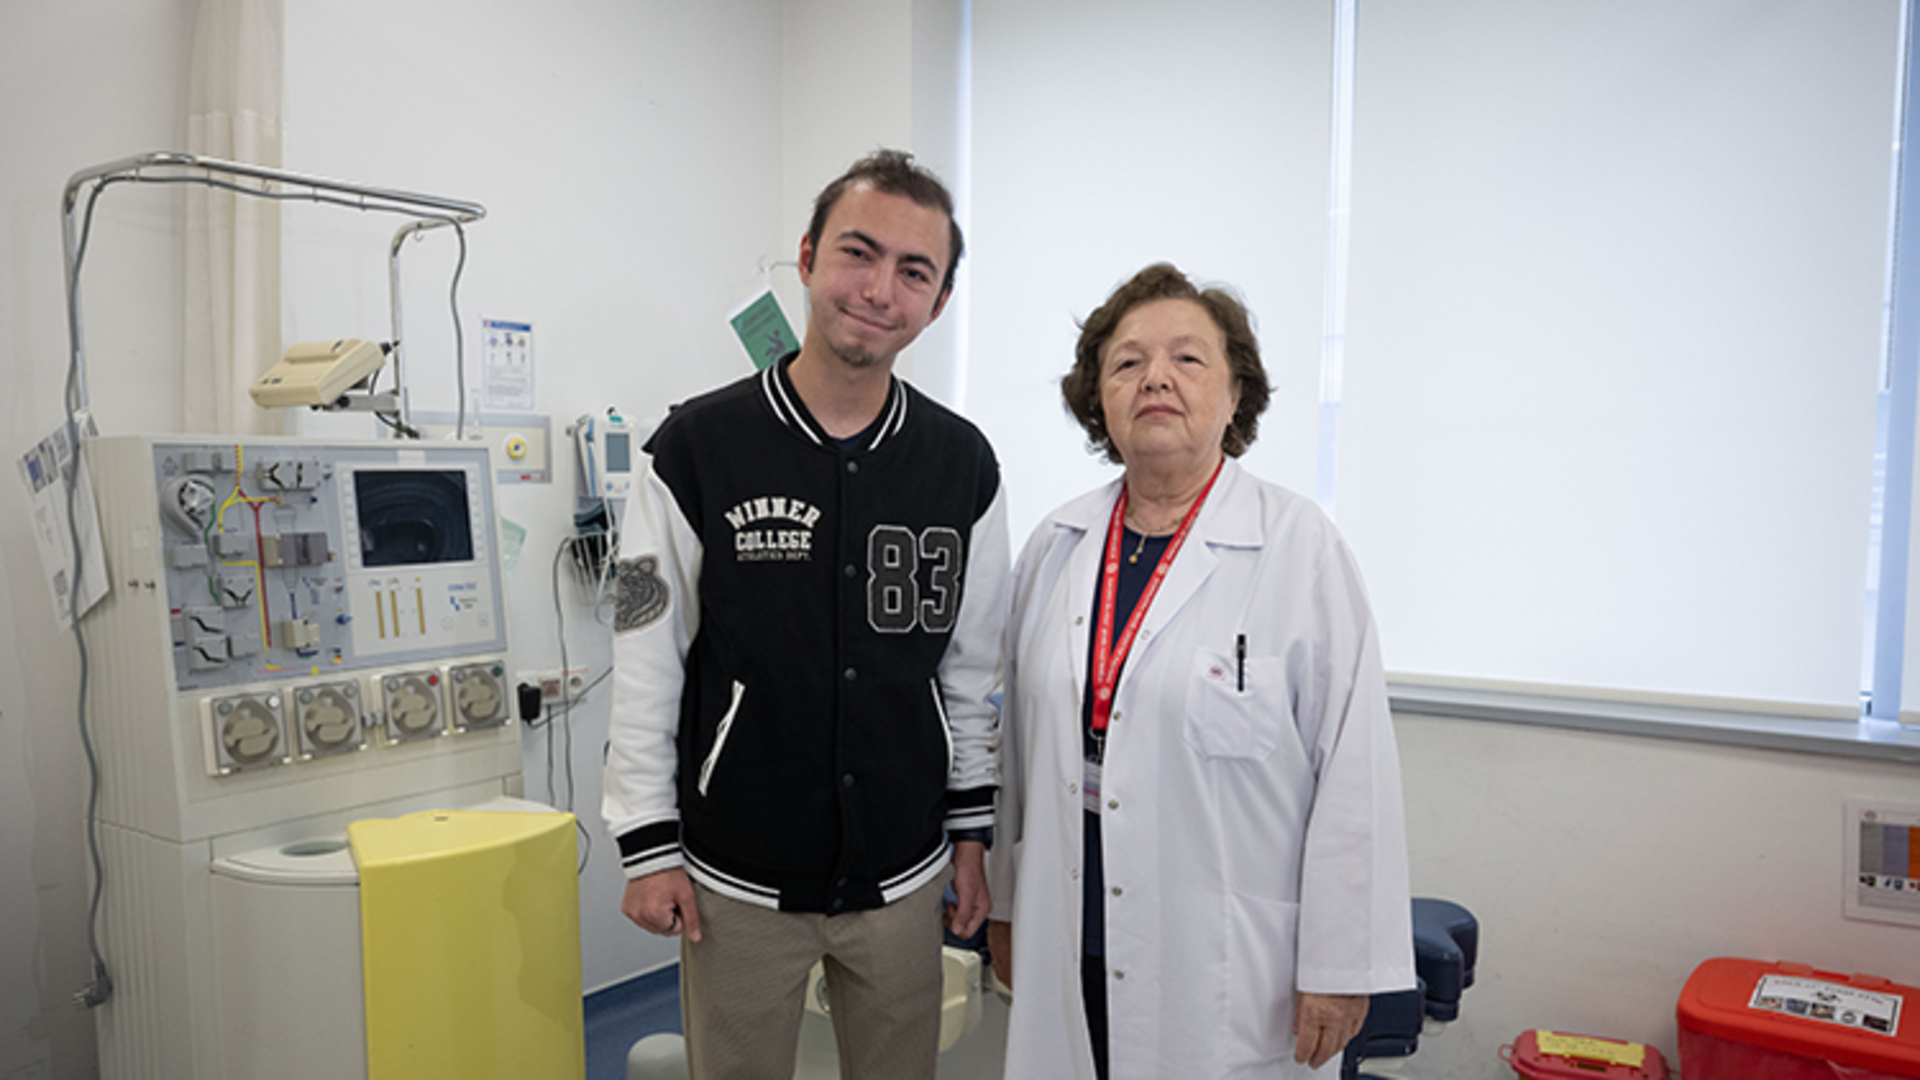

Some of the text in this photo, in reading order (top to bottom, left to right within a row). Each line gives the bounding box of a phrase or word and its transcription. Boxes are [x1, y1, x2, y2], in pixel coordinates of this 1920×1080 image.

[724, 497, 822, 530] WINNER
[735, 530, 812, 552] COLLEGE
[867, 524, 962, 634] 83
